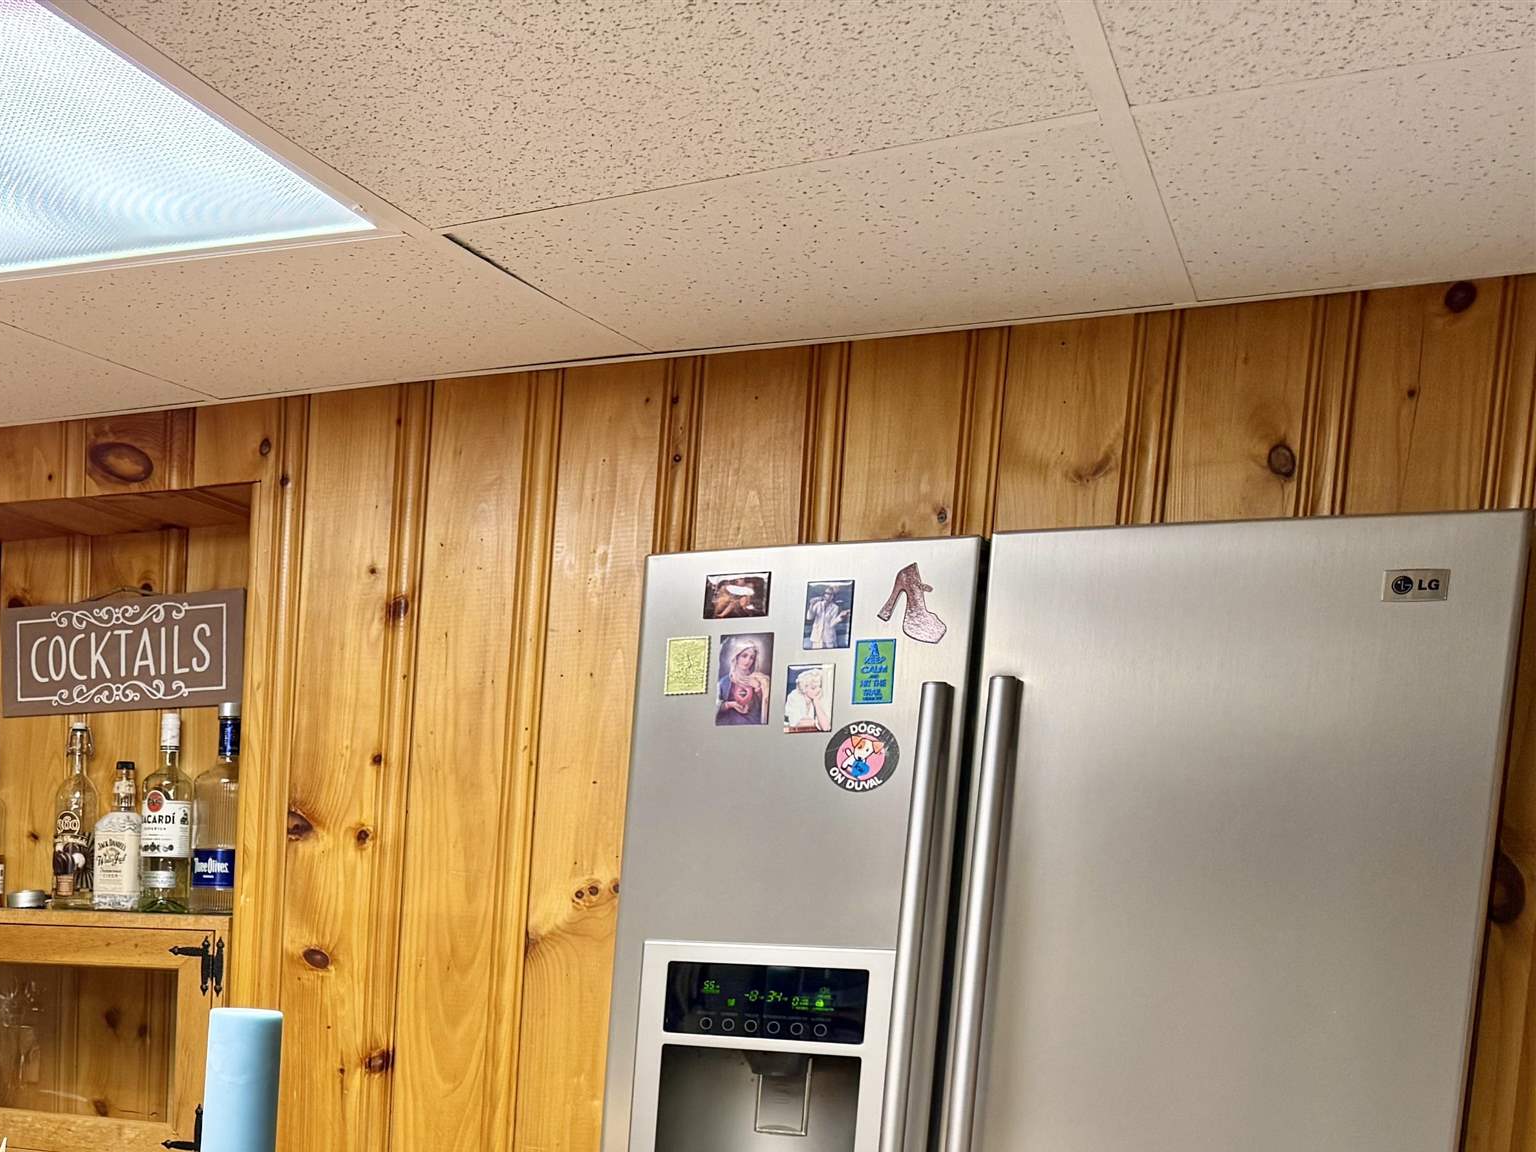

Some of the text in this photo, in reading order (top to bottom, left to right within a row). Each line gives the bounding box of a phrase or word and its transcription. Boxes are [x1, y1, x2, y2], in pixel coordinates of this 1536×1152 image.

[1417, 579, 1440, 591] LG
[30, 623, 211, 683] COCKTAILS
[864, 655, 887, 665] KEEP
[860, 664, 889, 674] CALM
[849, 722, 883, 738] DOGS
[829, 766, 883, 791] ON DUVAL
[143, 812, 176, 825] ACARDÍ
